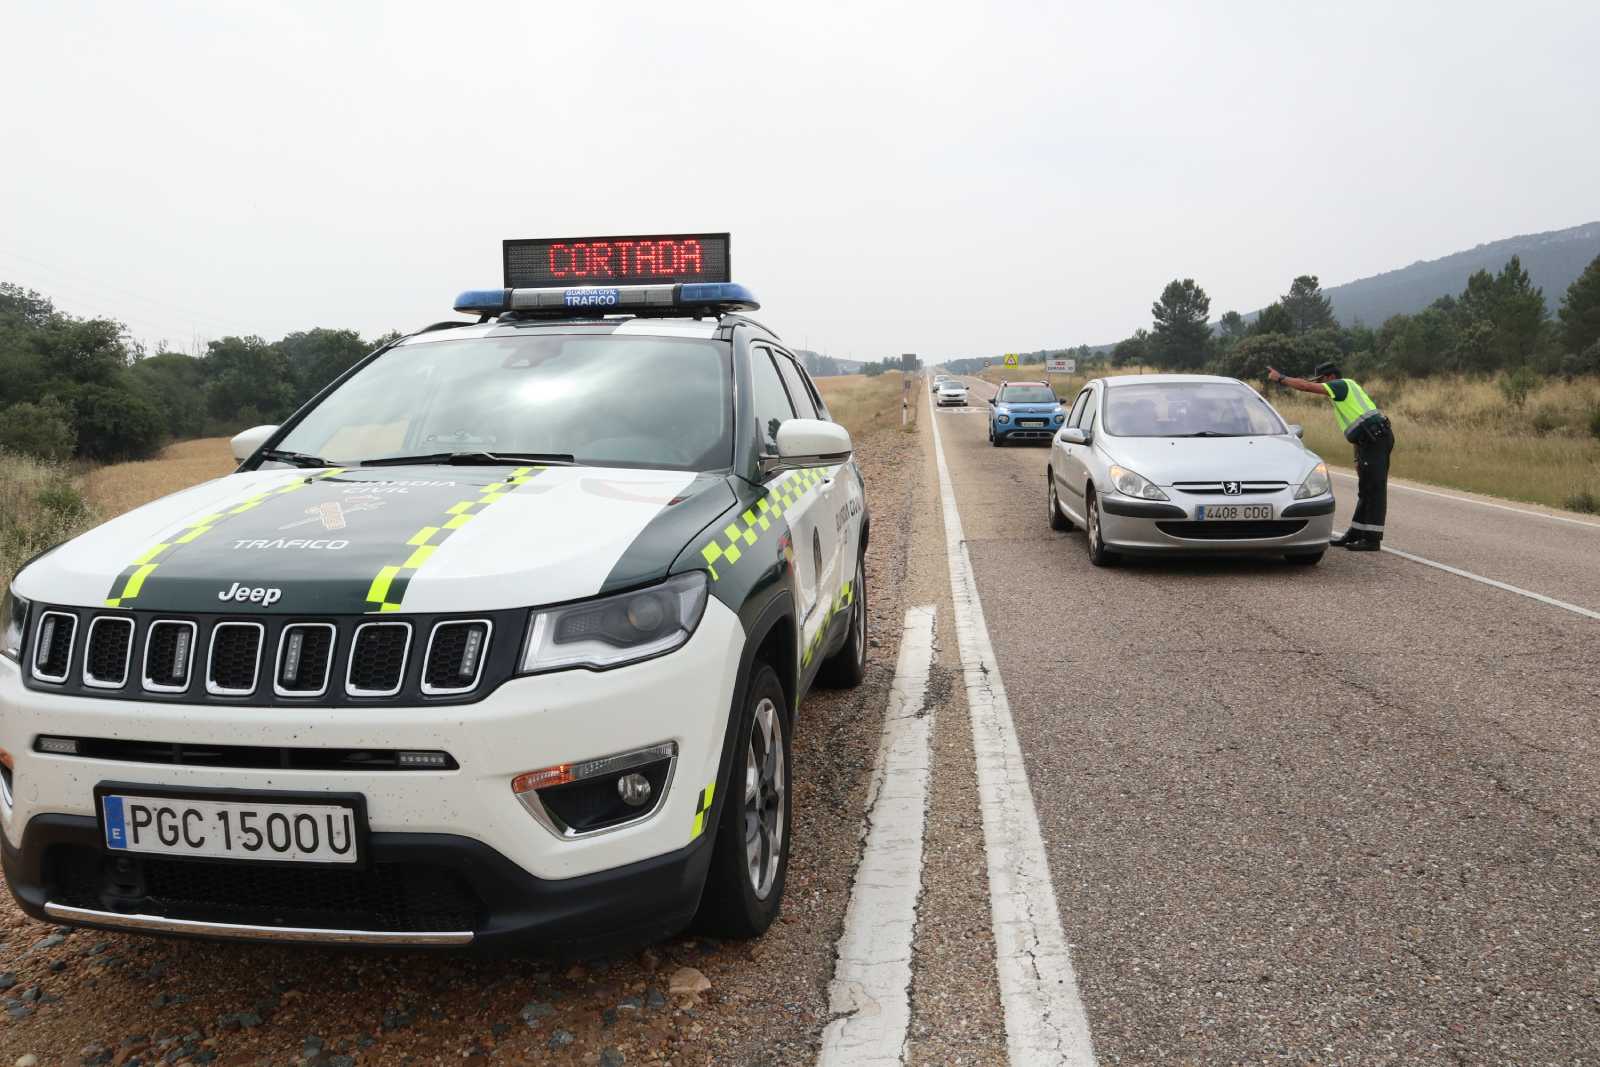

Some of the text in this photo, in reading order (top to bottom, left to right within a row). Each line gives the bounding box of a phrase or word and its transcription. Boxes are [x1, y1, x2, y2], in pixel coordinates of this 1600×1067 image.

[549, 240, 703, 277] CORTADA
[565, 295, 616, 306] TRAFICO
[1207, 506, 1269, 519] 4408 CDG
[218, 583, 282, 607] Jeep
